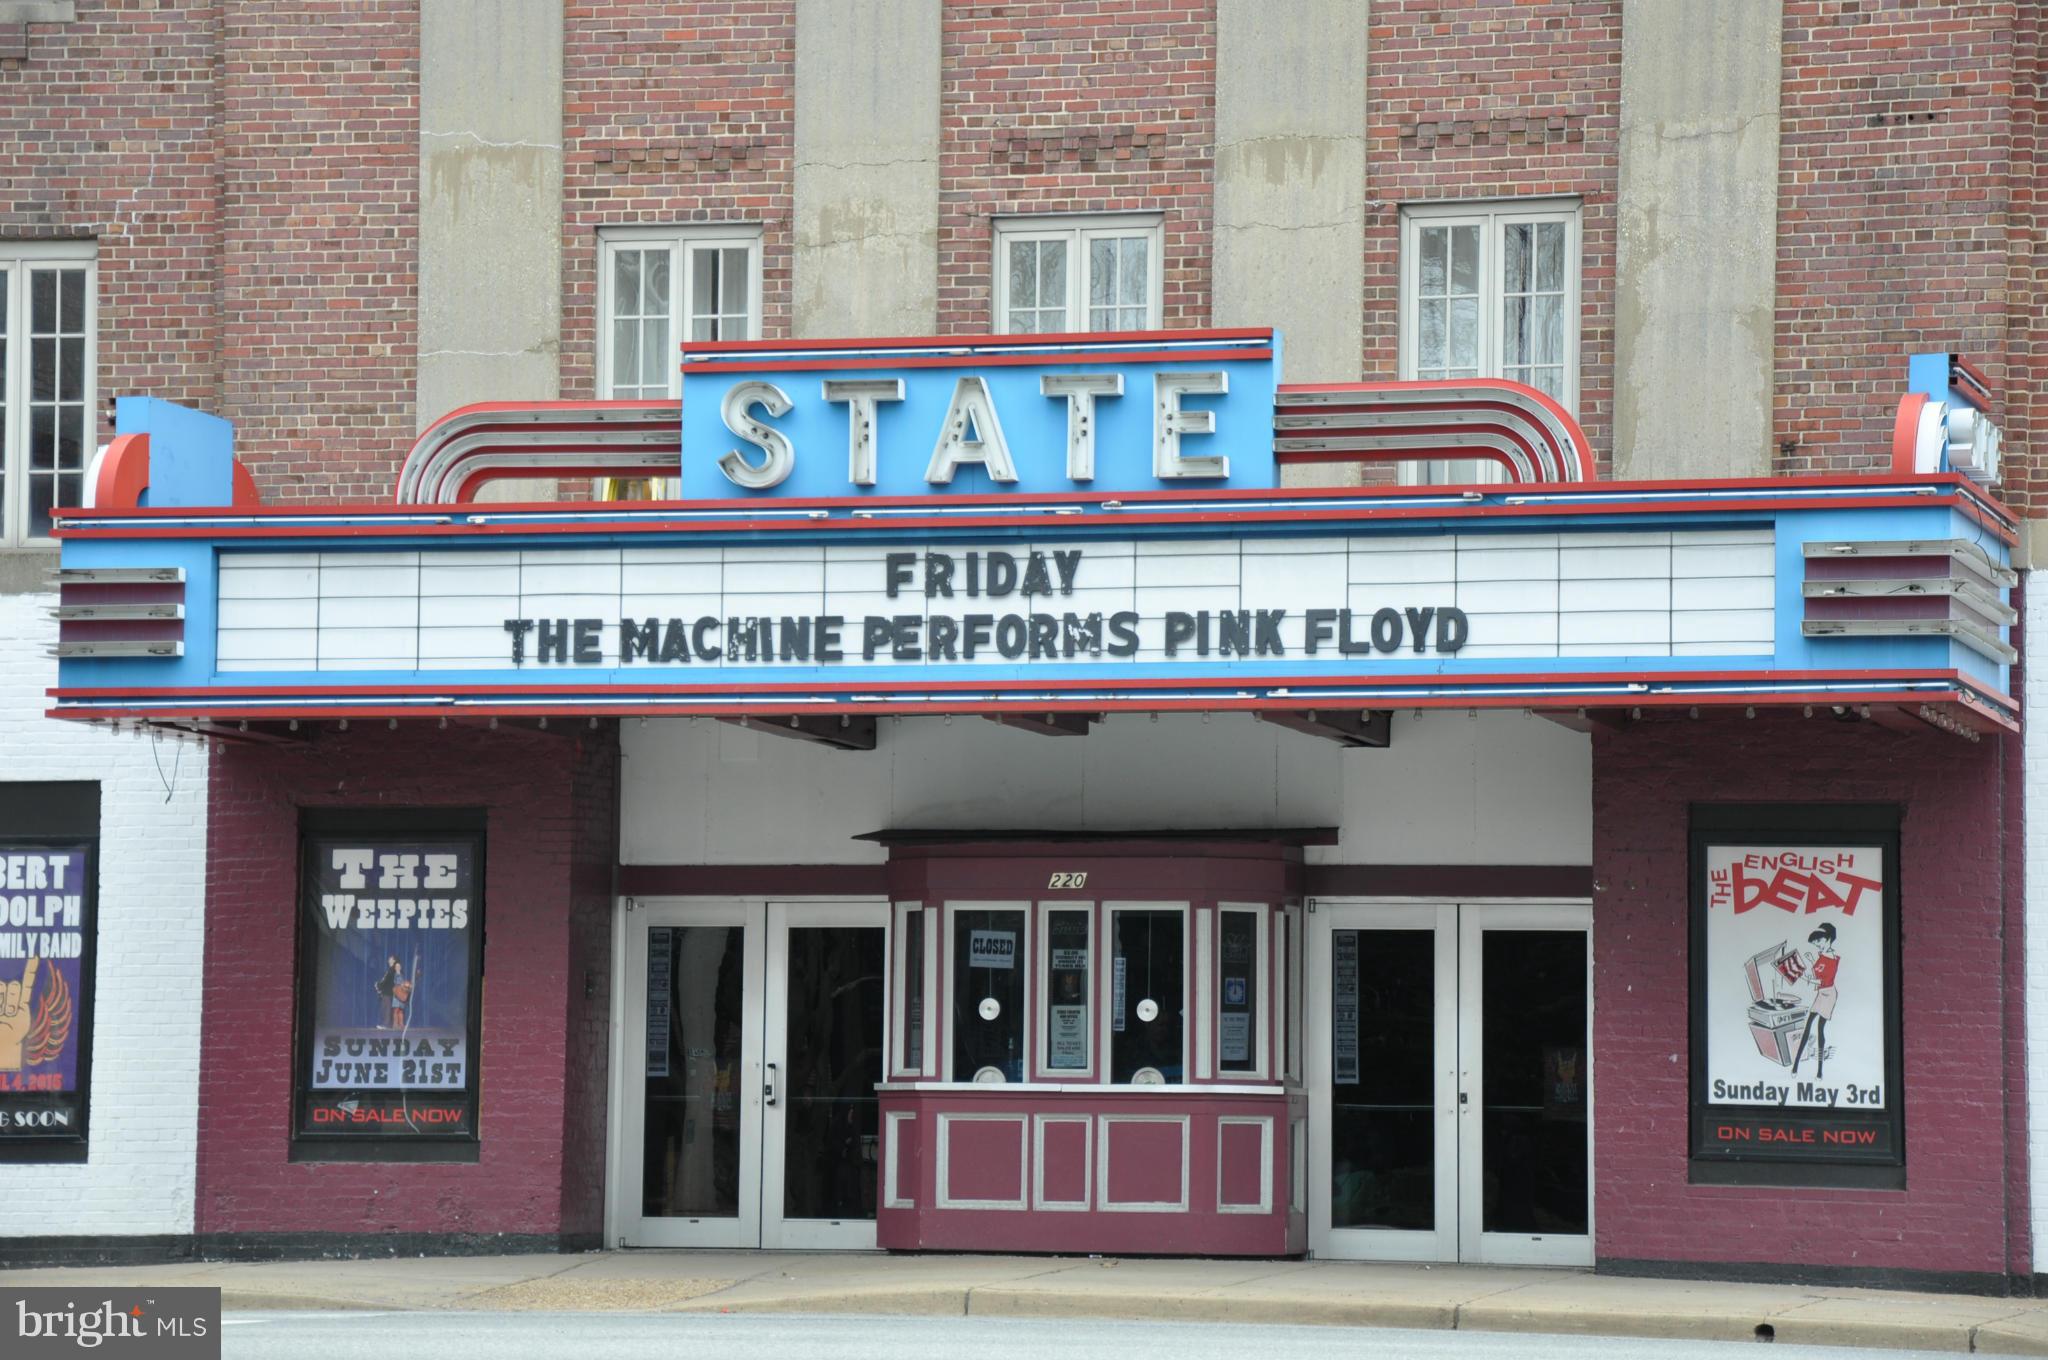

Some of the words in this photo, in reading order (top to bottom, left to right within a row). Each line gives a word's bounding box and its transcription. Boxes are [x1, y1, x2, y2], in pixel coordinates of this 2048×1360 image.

[717, 371, 1230, 488] STATE
[886, 550, 1082, 598] FRIDAY
[504, 618, 602, 663] THE
[620, 616, 844, 663] MACHINE
[862, 611, 1139, 661] PERFORMS
[1164, 609, 1286, 657] PINK
[1304, 607, 1469, 655] FLOYD
[332, 848, 458, 890] THE
[1743, 852, 1855, 875] ENGLISH
[1050, 873, 1085, 888] 220
[1710, 868, 1731, 908] THE
[321, 894, 469, 930] WEEPIES
[40, 932, 82, 958] BAND
[973, 938, 1013, 955] CLOSED
[323, 1036, 460, 1058] SUNDAY
[28, 1073, 63, 1091] 2015
[316, 1059, 389, 1084] JUNE
[402, 1059, 461, 1084] 21ST
[1713, 1079, 1790, 1107] Sunday
[1796, 1083, 1839, 1108] May
[1846, 1083, 1881, 1105] 3rd
[14, 1111, 68, 1127] SOON
[313, 1108, 347, 1123] ON
[351, 1108, 406, 1123] SALE
[412, 1108, 462, 1123] NOW
[1717, 1126, 1750, 1141] ON
[1758, 1128, 1816, 1143] SALE
[1823, 1130, 1876, 1144] NOW
